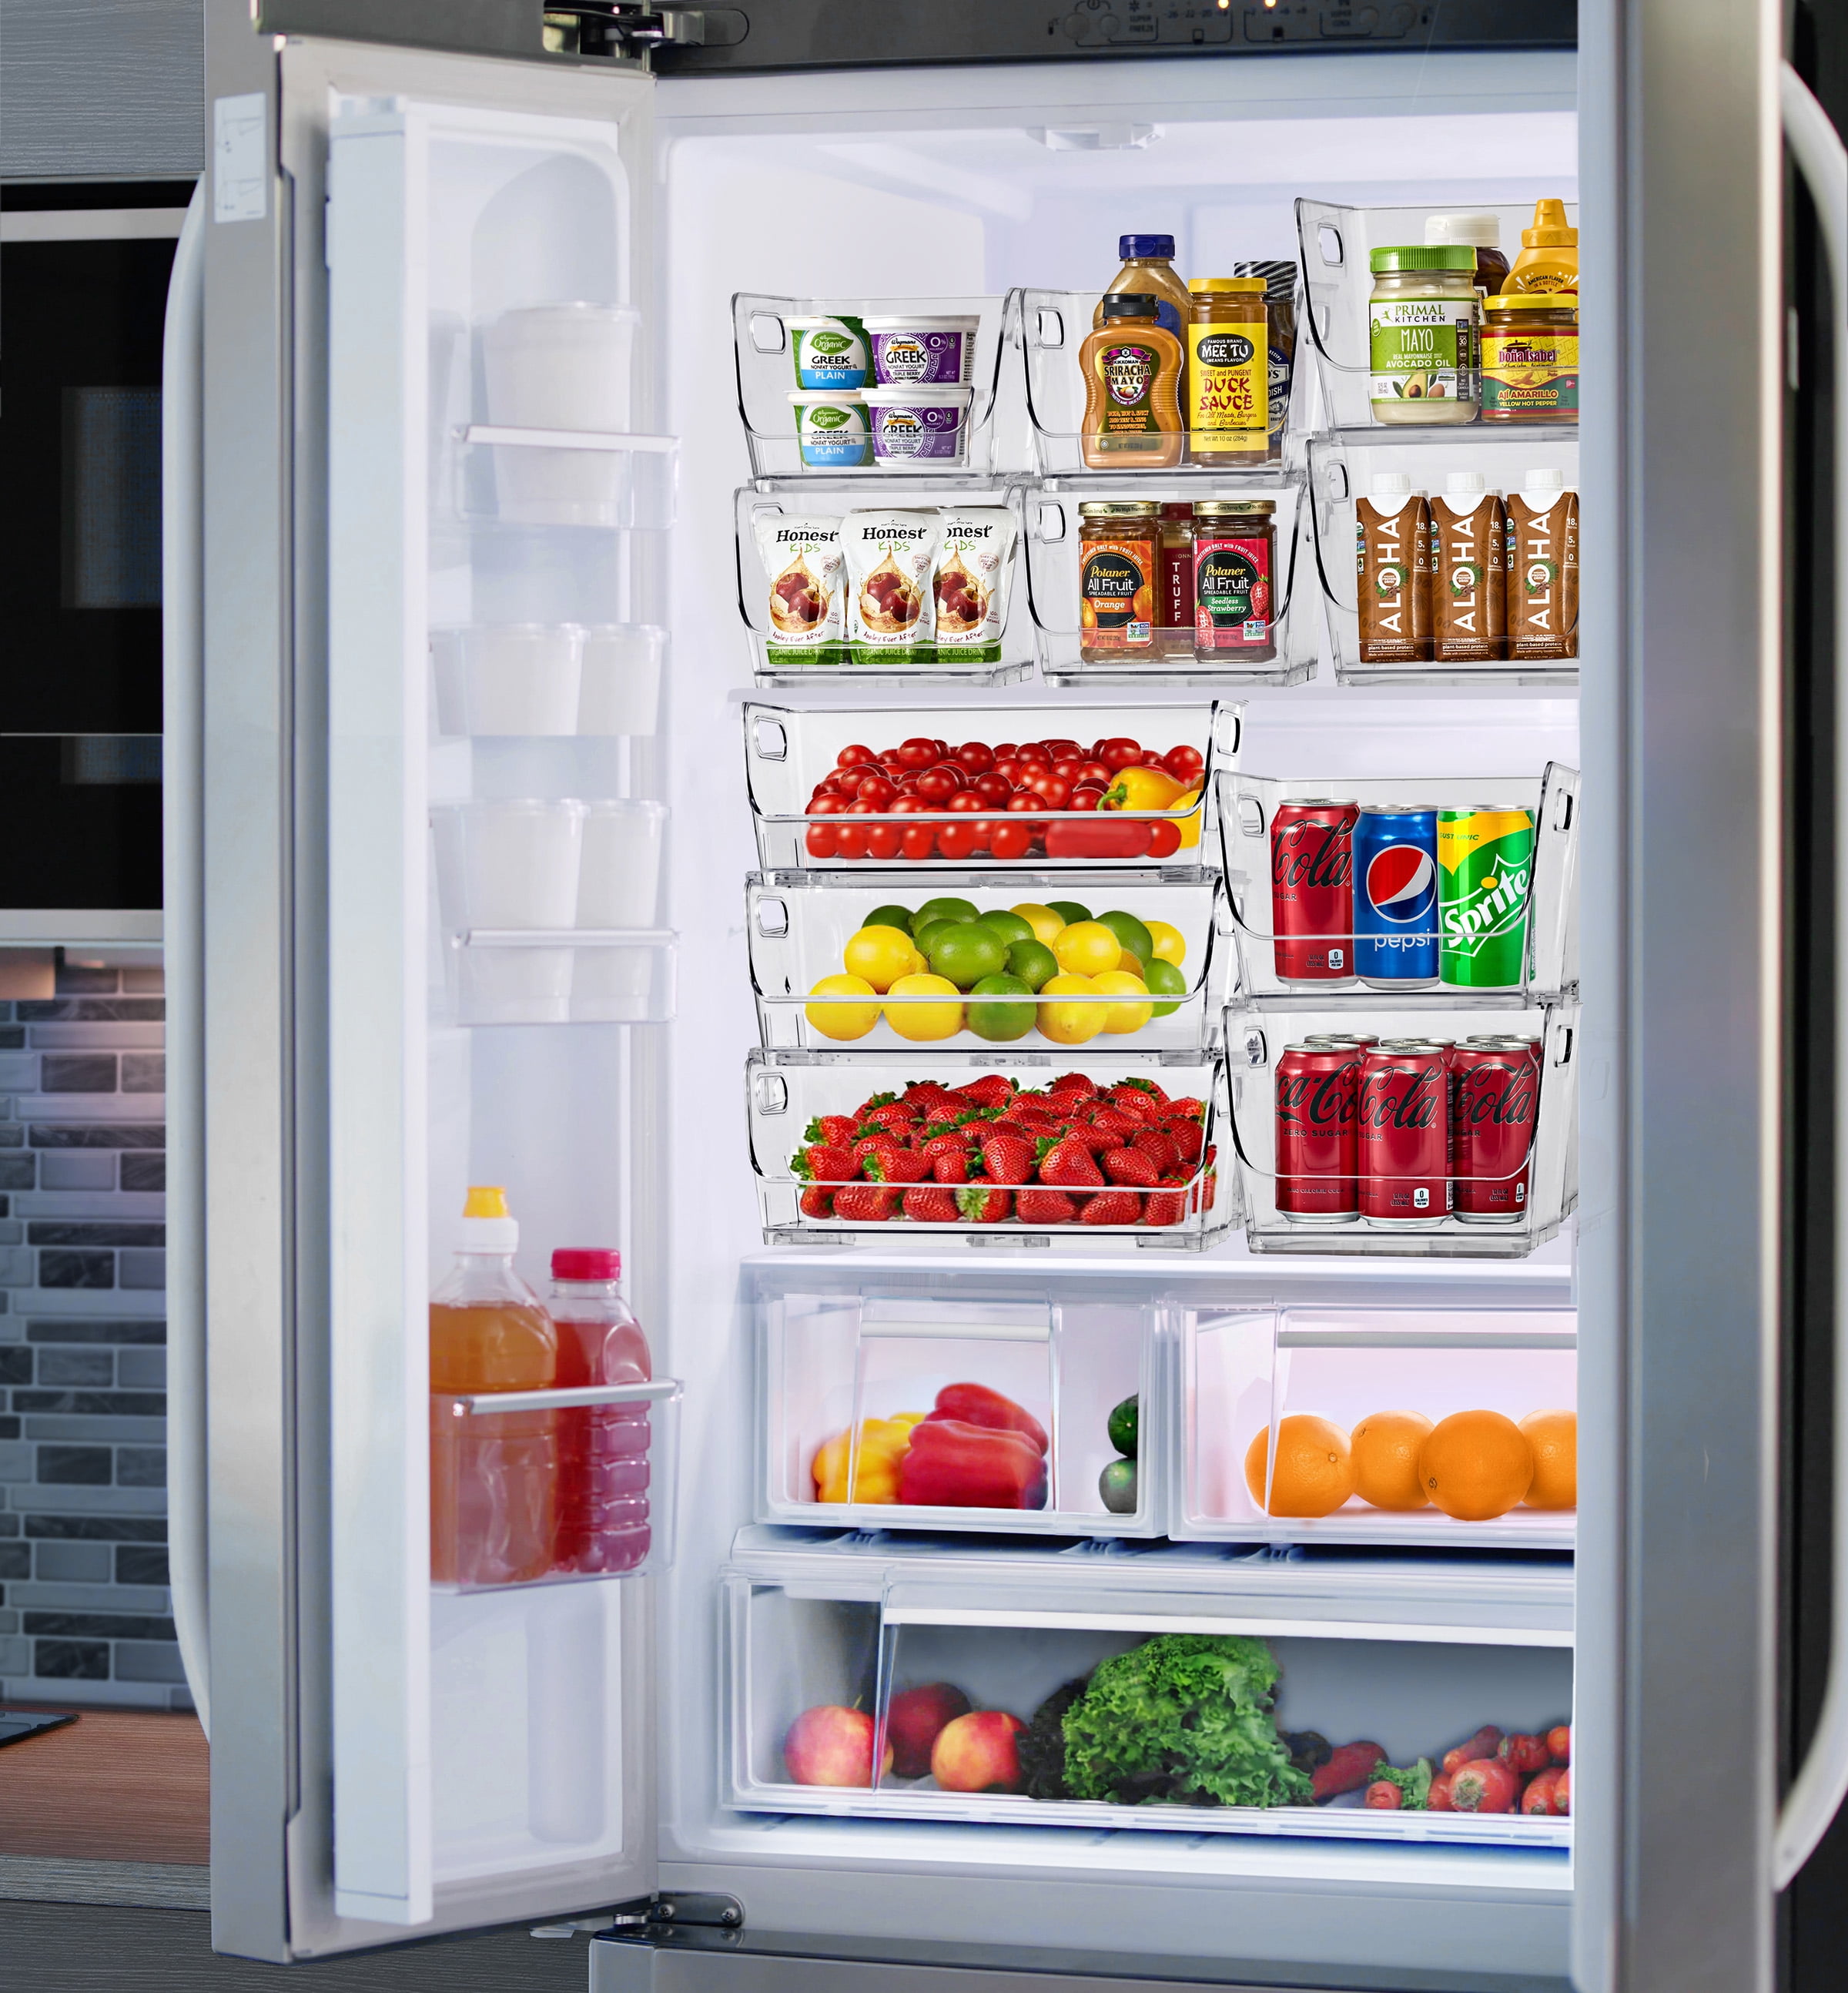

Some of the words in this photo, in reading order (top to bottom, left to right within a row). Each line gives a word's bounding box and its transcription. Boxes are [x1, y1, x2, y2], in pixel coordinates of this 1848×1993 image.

[1528, 274, 1548, 286] AMERICAN
[1395, 304, 1445, 316] PRIMAL
[892, 338, 916, 347] Wegmans
[1401, 328, 1434, 352] MAYO
[886, 350, 926, 363] GREEK
[1201, 344, 1227, 357] MEE
[1230, 344, 1249, 357] TU
[1269, 349, 1282, 361] RECIPE
[1499, 349, 1524, 363] Doña
[1525, 349, 1557, 362] Isabel
[812, 355, 850, 364] GREEK
[1386, 360, 1432, 368] AVOCADO
[1104, 365, 1152, 376] SRIRACHA
[1111, 376, 1144, 385] MAYO
[1204, 377, 1251, 394] DUCK
[1511, 390, 1558, 399] AMARILLO
[1199, 394, 1254, 411] SAUCE
[889, 411, 912, 421] Wegmans
[1237, 410, 1257, 421] Burgers
[883, 424, 922, 437] GREEK
[776, 529, 839, 543] Honest
[862, 527, 927, 540] Honest
[1119, 546, 1133, 556] FRUIT
[1132, 554, 1143, 566] JUICE
[1234, 544, 1248, 554] FRUIT
[1247, 551, 1259, 564] JUICE
[1568, 553, 1574, 561] 0
[1090, 565, 1130, 578] Polaner
[1205, 564, 1246, 577] Polaner
[1377, 517, 1402, 633] ALOHA
[1451, 515, 1476, 632] ALOHA
[1528, 512, 1551, 629] ALOHA
[1088, 578, 1100, 591] All
[1203, 578, 1215, 590] All
[1172, 562, 1182, 621] TRUFF
[1094, 600, 1125, 610] Orange
[1207, 605, 1247, 613] Strawberry
[772, 631, 788, 643] Appley
[790, 634, 804, 642] Ever
[863, 631, 882, 643] Appley
[882, 634, 897, 642] Ever
[949, 634, 963, 642] Ever
[1273, 816, 1357, 888] Cola
[1445, 869, 1528, 949] Sprite
[1374, 928, 1431, 952] pepsi
[1334, 951, 1338, 960] 0
[1358, 1065, 1442, 1129] Cola
[1452, 1060, 1535, 1124] Cola
[1284, 1128, 1307, 1137] ZERO
[1311, 1129, 1348, 1137] SUGAR
[1419, 1190, 1424, 1198] 0
